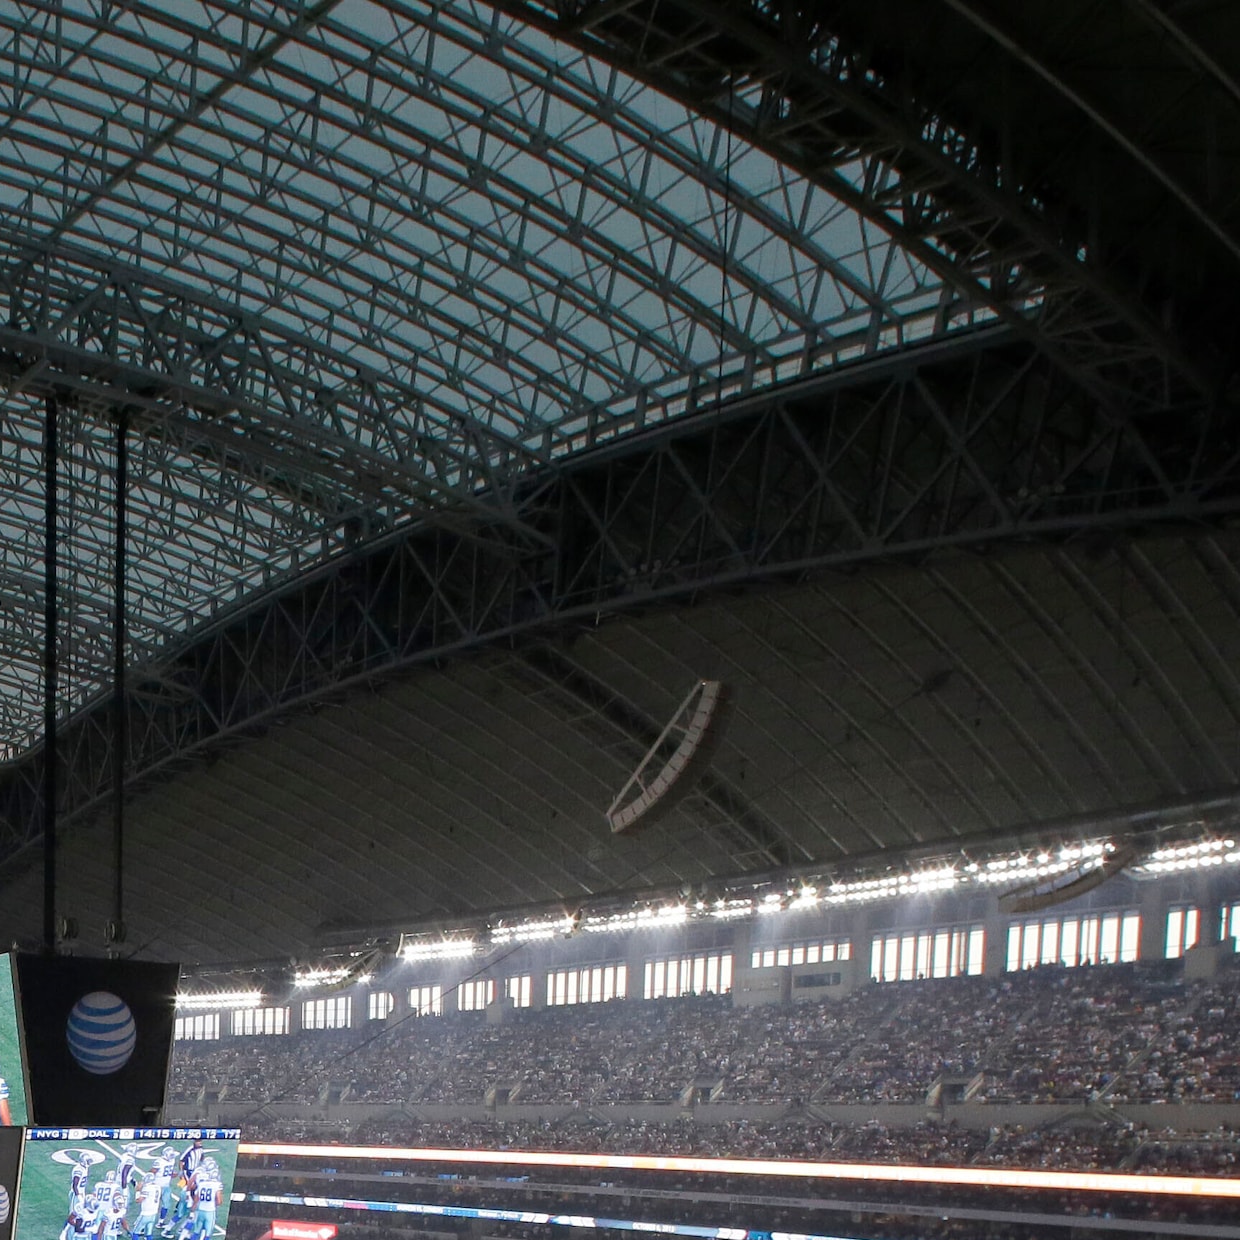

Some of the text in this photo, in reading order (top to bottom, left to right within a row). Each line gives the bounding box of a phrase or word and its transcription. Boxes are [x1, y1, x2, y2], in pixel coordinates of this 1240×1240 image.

[36, 1130, 60, 1138] NYG
[88, 1130, 110, 1138] DAL
[139, 1129, 170, 1138] 14:15
[97, 1187, 110, 1202] 82
[200, 1187, 213, 1202] 68
